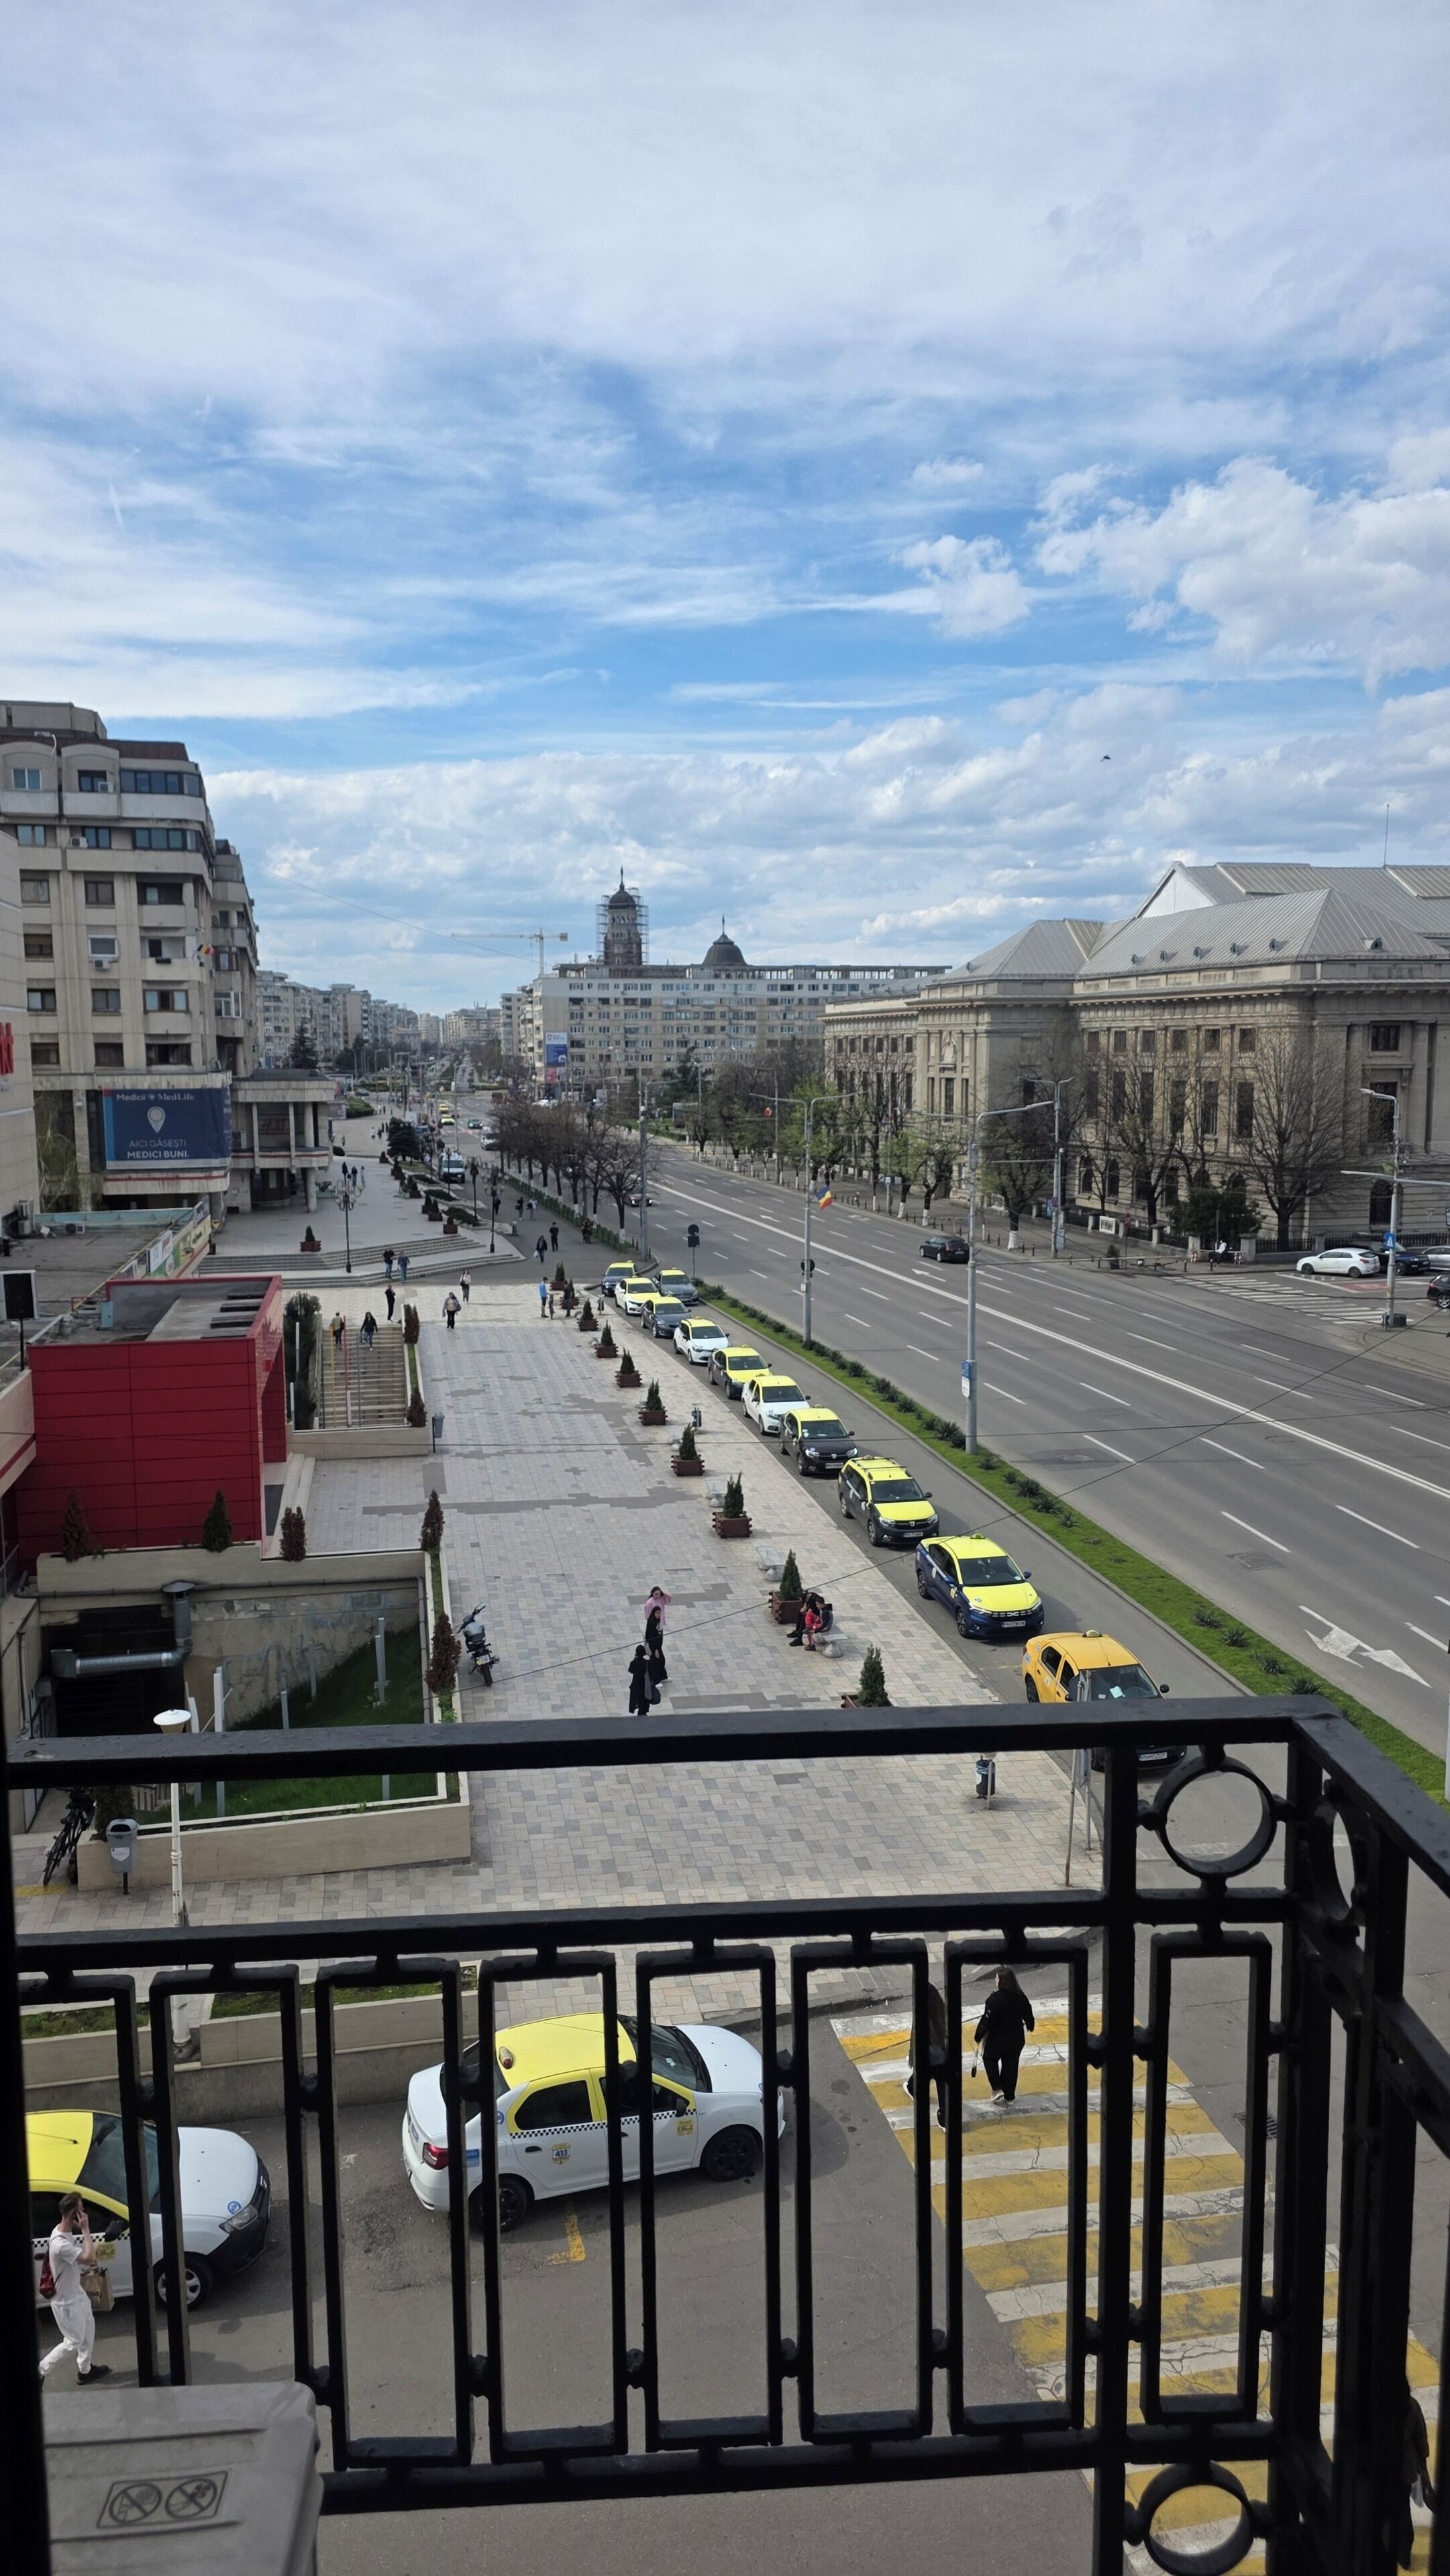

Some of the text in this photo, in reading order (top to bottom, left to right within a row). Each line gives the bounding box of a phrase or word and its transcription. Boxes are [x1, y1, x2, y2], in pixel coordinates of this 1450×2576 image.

[116, 1093, 195, 1101] Medicii MedLife
[129, 1140, 148, 1148] AICI
[127, 1150, 190, 1159] MEDICI BUNI.
[555, 2149, 568, 2157] 413
